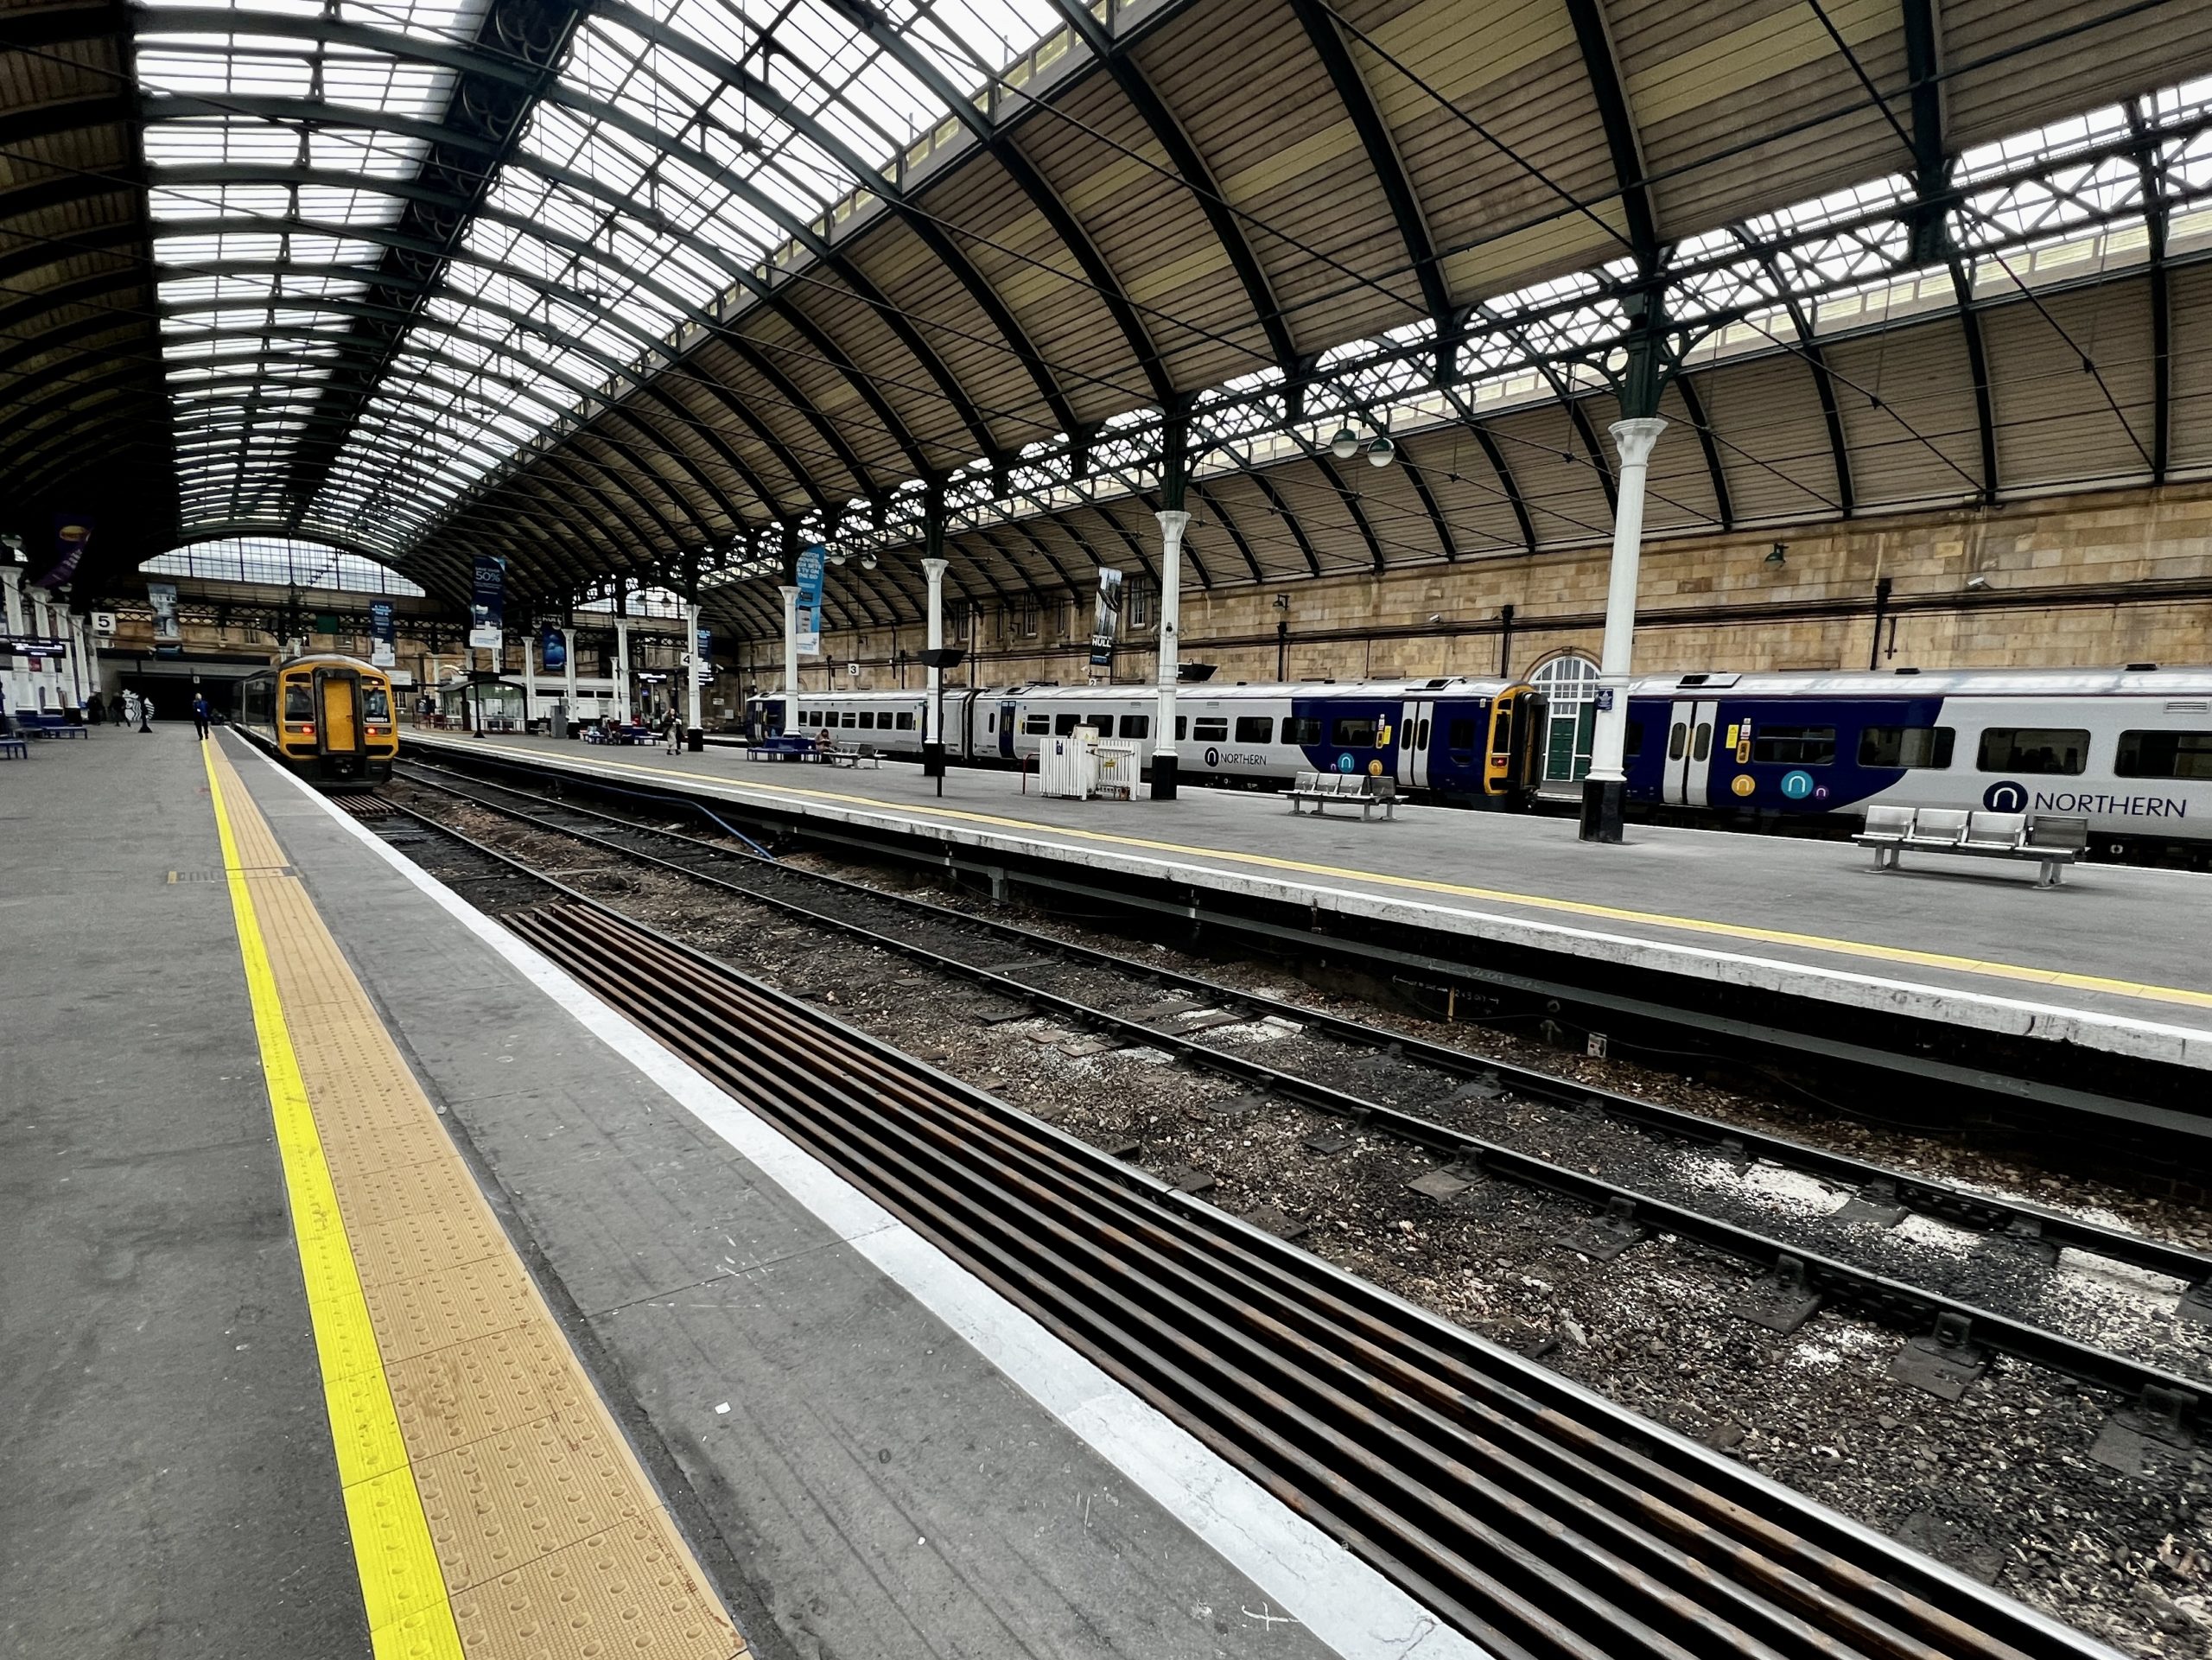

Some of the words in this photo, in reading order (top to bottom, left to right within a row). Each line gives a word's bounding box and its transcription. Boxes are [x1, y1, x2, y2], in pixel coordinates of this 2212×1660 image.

[475, 570, 500, 582] 50%
[98, 615, 111, 628] 5
[1091, 638, 1112, 648] HULL
[683, 655, 690, 664] 4
[850, 665, 856, 674] 3
[1220, 754, 1267, 766] NORTHERN
[2034, 792, 2187, 818] NORTHERN
